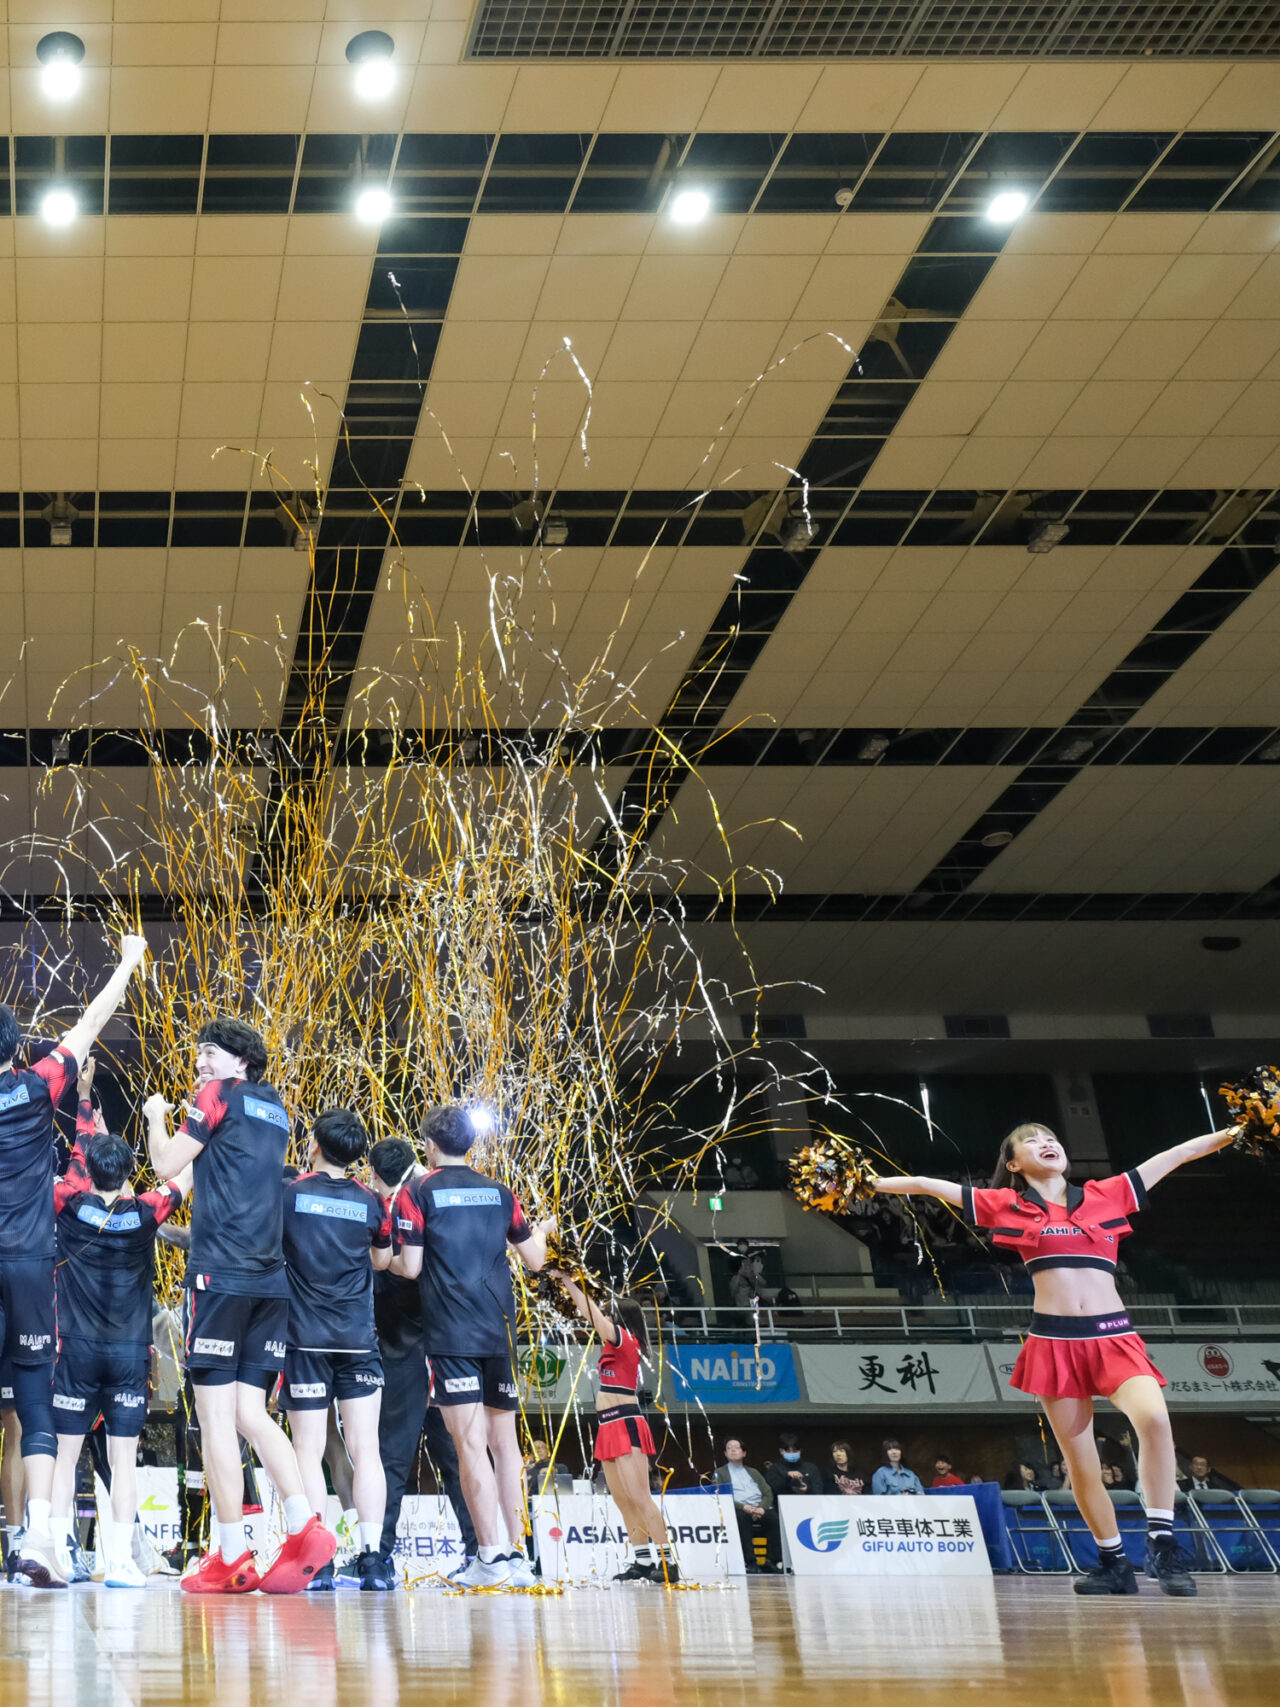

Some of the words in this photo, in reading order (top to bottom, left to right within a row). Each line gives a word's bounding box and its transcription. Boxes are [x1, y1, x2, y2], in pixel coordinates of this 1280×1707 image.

[464, 1195, 500, 1204] ACTIVE
[326, 1206, 367, 1220] ACTIVE
[105, 1218, 141, 1229] ACTIVE
[1040, 1226, 1069, 1236] SAHI
[858, 1351, 940, 1395] 更科
[1170, 1380, 1280, 1393] だるまミート株式会社
[566, 1525, 629, 1544] ASAH
[669, 1525, 729, 1544] ORGE
[856, 1518, 974, 1538] 岐阜車体工業
[862, 1541, 894, 1552] GIFU
[897, 1541, 934, 1552] AUTO
[938, 1541, 975, 1553] BODY
